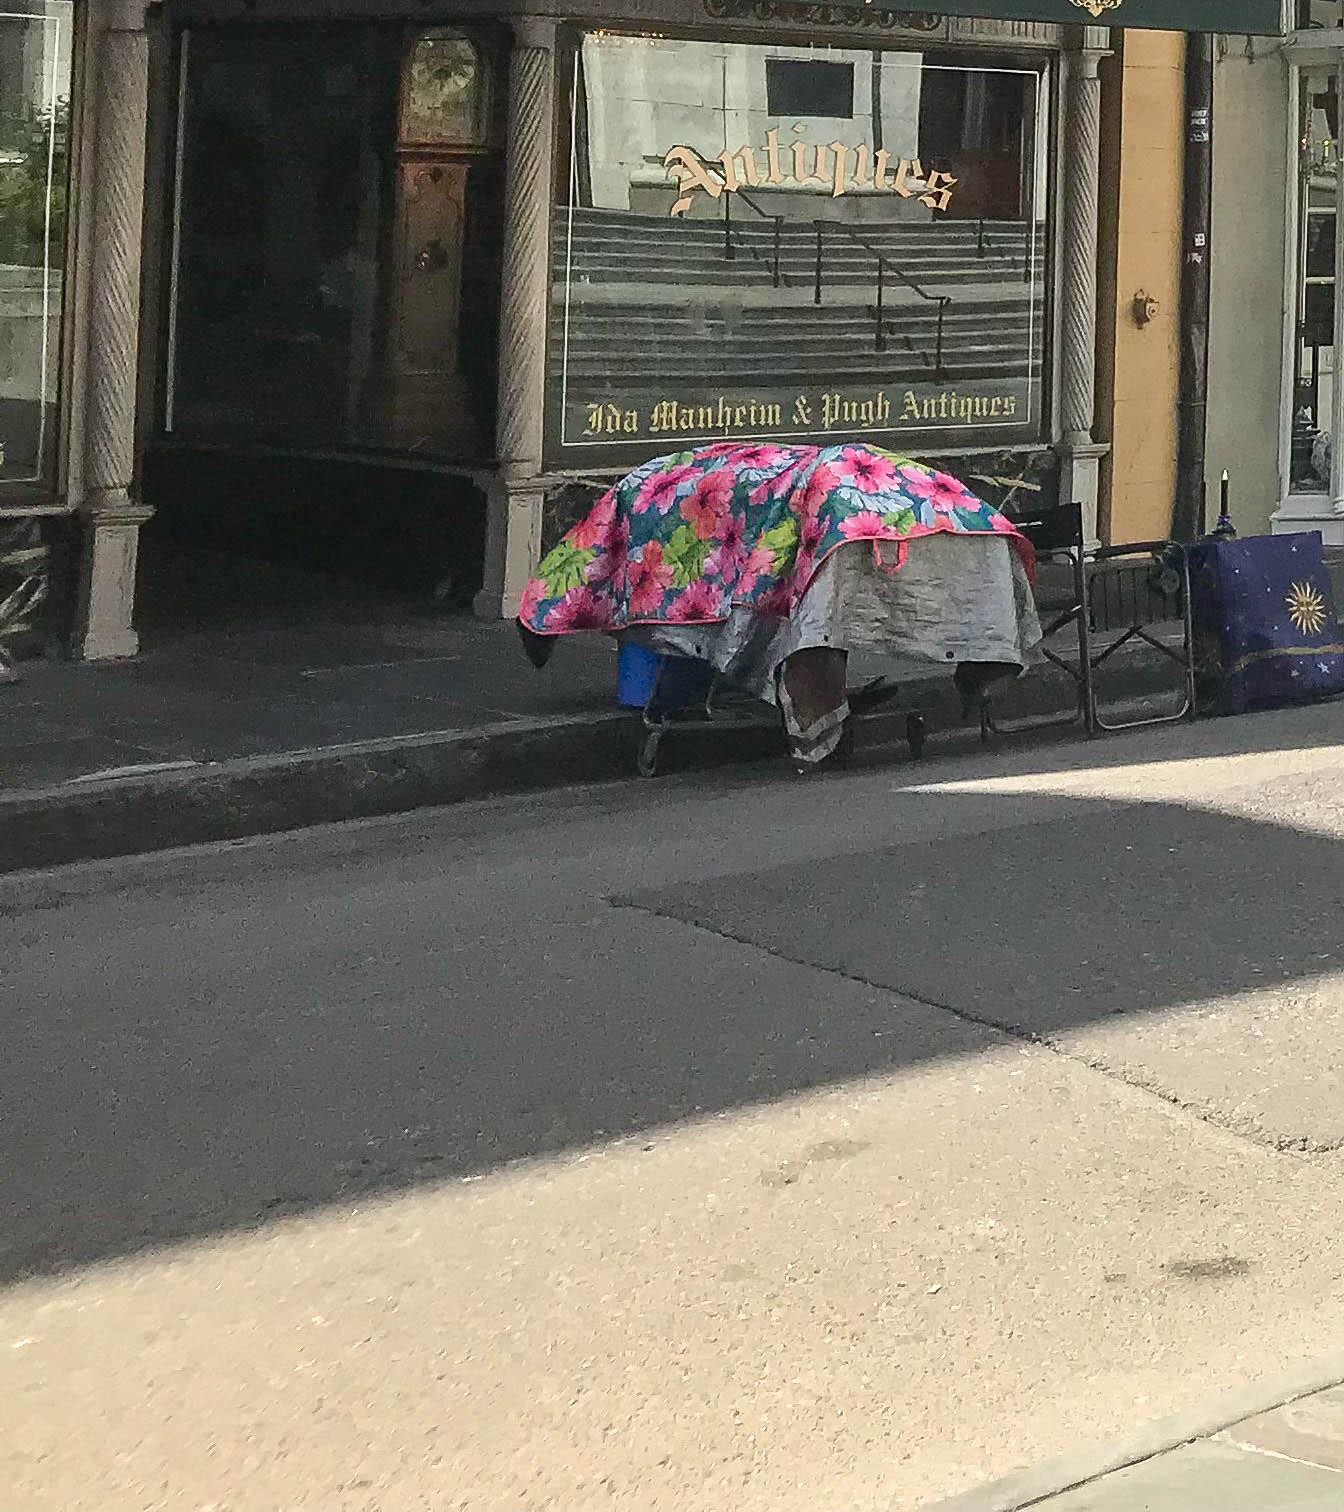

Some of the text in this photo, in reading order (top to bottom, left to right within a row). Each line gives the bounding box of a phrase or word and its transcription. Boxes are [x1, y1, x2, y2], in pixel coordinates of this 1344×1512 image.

[664, 121, 958, 217] Antiques
[582, 390, 1016, 436] Ida Manheim & Pugh Antiques
